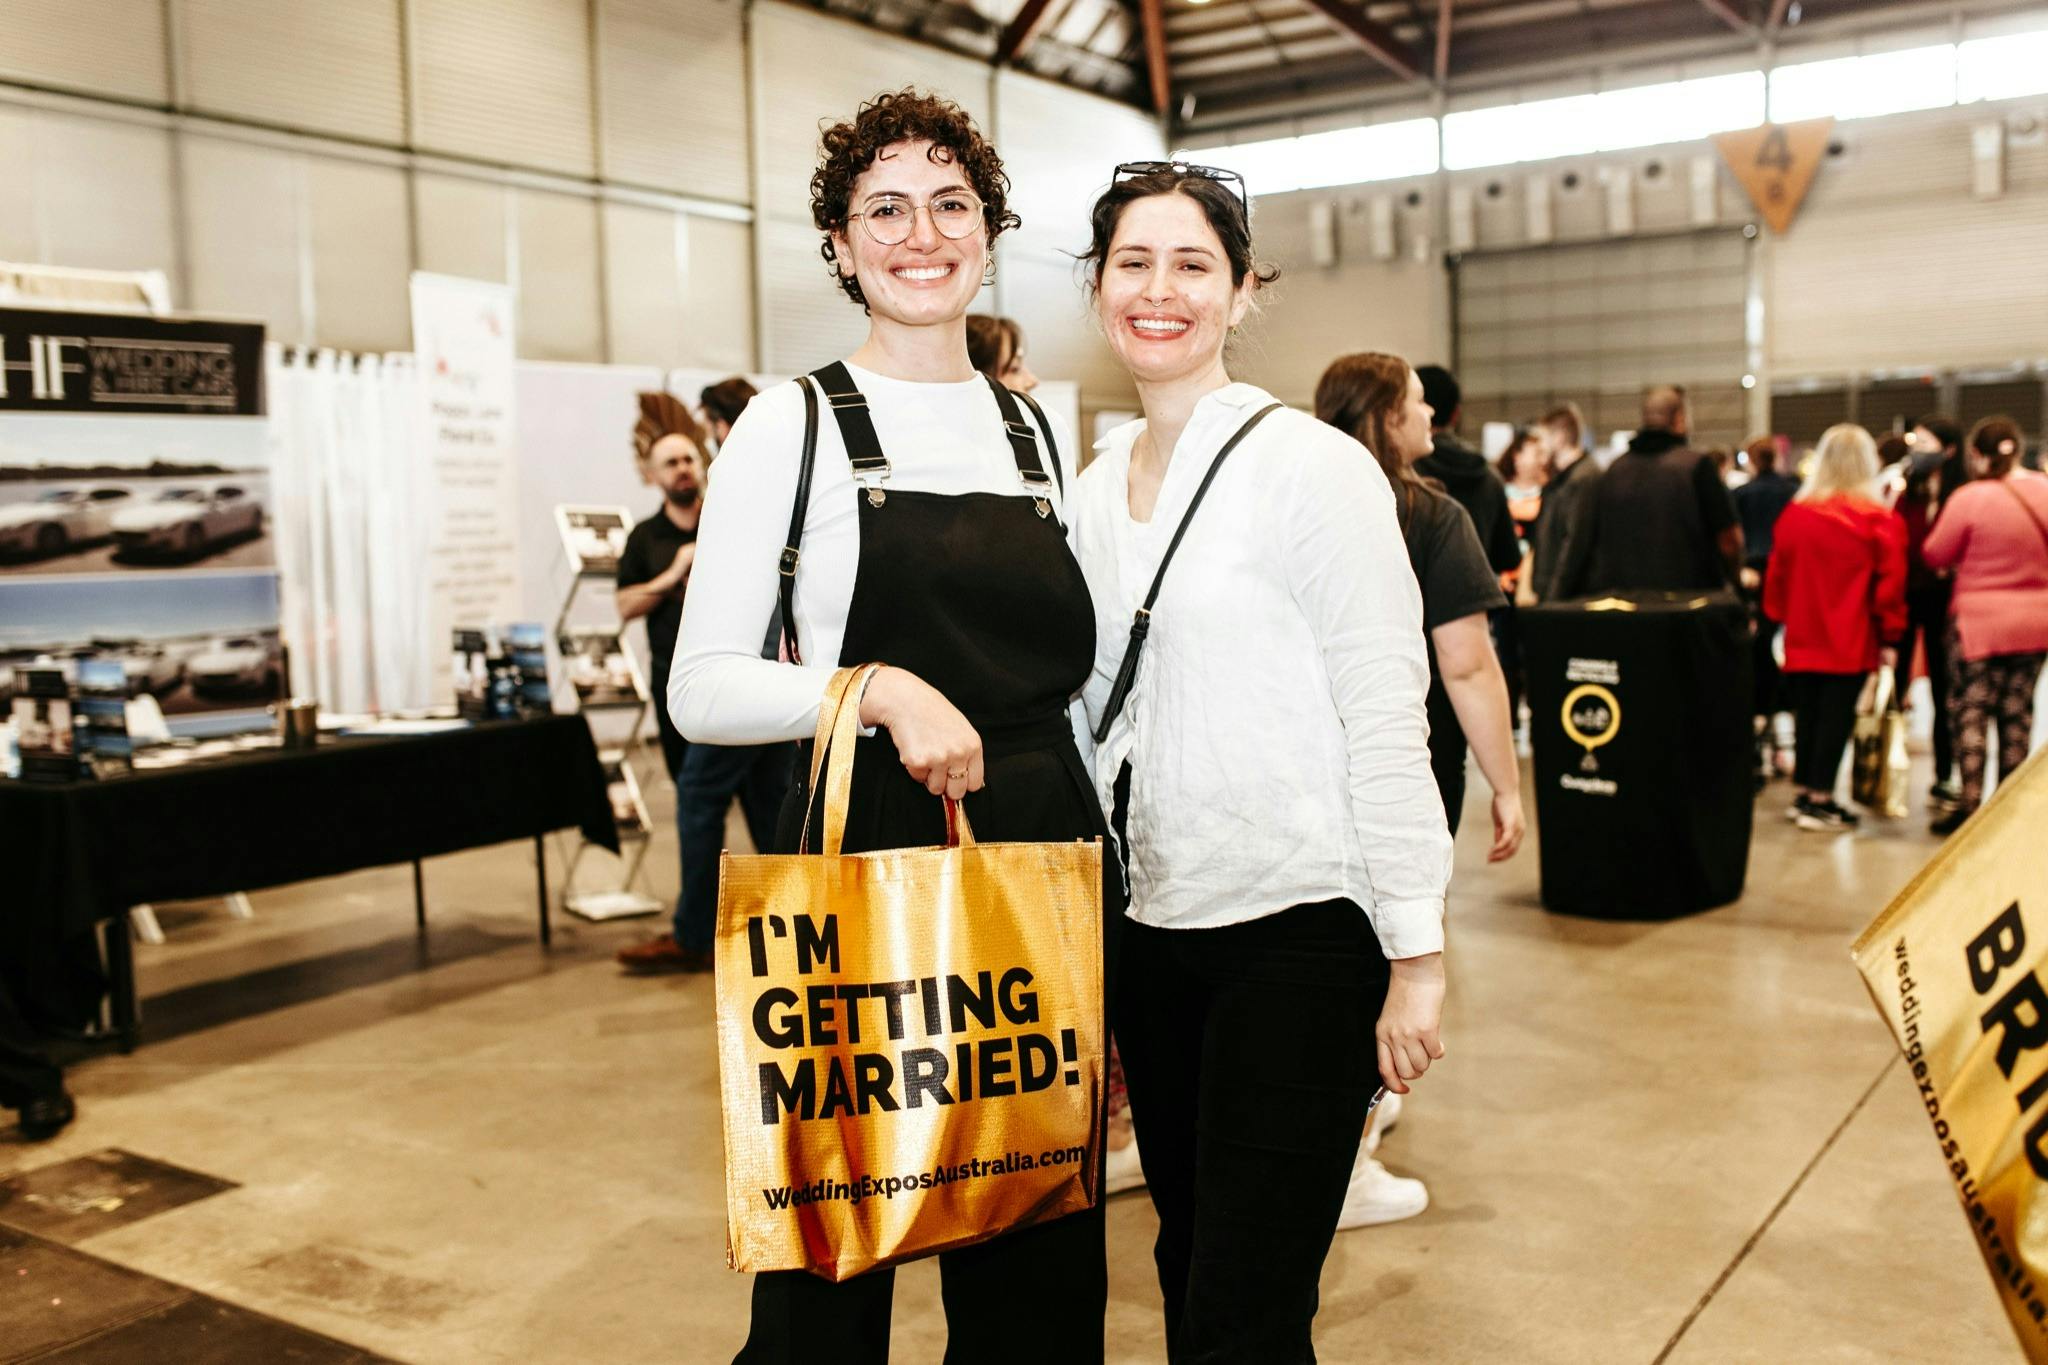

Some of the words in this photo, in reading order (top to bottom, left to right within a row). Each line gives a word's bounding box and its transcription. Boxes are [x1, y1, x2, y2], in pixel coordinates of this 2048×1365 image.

[88, 347, 236, 378] WEDDING
[748, 914, 840, 977] I'M
[752, 967, 1039, 1049] GETTING
[758, 1029, 1080, 1125] MARRIED!
[762, 1144, 1087, 1210] WeddingExposAustralia.com
